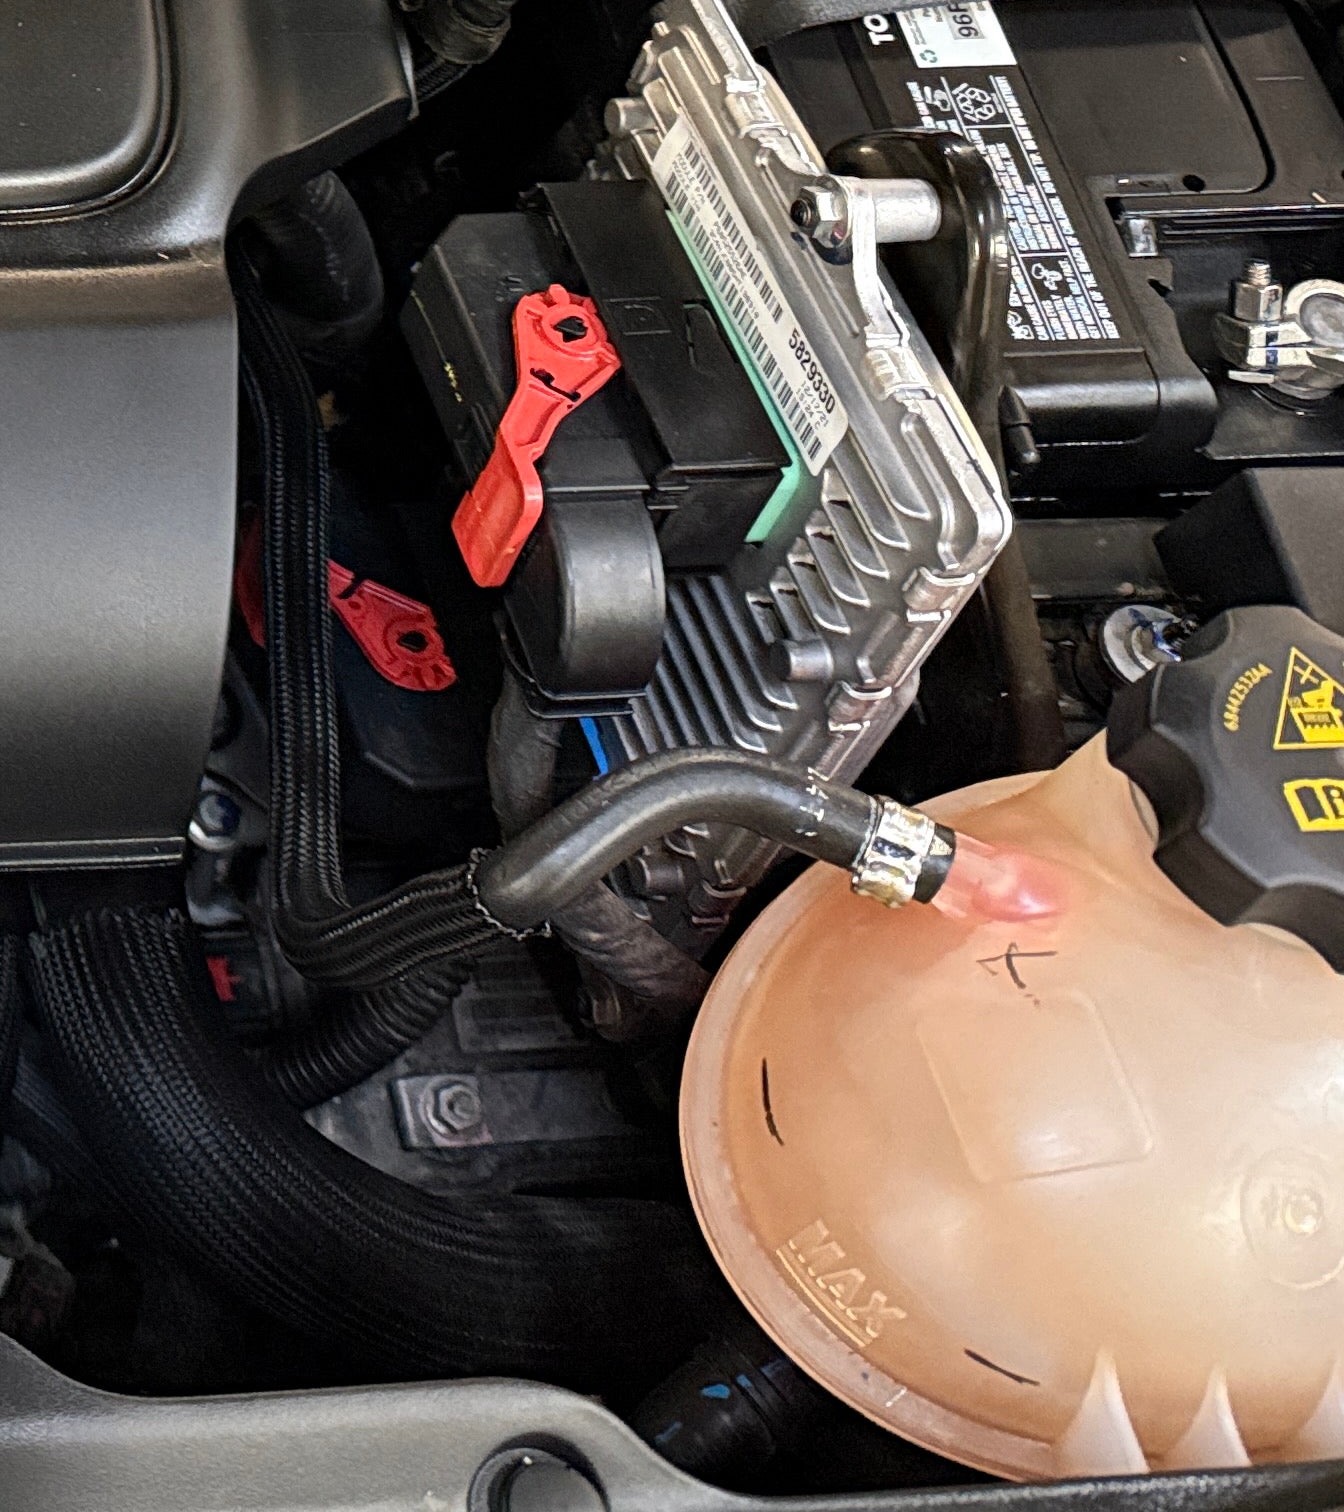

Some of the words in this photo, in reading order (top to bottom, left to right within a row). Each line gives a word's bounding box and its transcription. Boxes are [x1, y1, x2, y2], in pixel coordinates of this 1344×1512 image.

[1007, 107, 1028, 125] OPEN
[1015, 125, 1034, 139] NOT
[1021, 139, 1039, 150] DO
[1033, 165, 1052, 181] NOT
[1040, 181, 1057, 193] DO
[1064, 235, 1080, 246] OF
[1068, 246, 1092, 272] REACH
[1064, 277, 1083, 295] HELP
[1080, 272, 1099, 289] THE
[1087, 289, 1104, 301] OF
[1072, 295, 1096, 324] MEDICAL
[1092, 301, 1112, 318] OUT
[1085, 325, 1102, 339] GET
[1099, 318, 1121, 339] KEEP
[786, 326, 838, 417] 5829330
[788, 1217, 908, 1339] MAX
